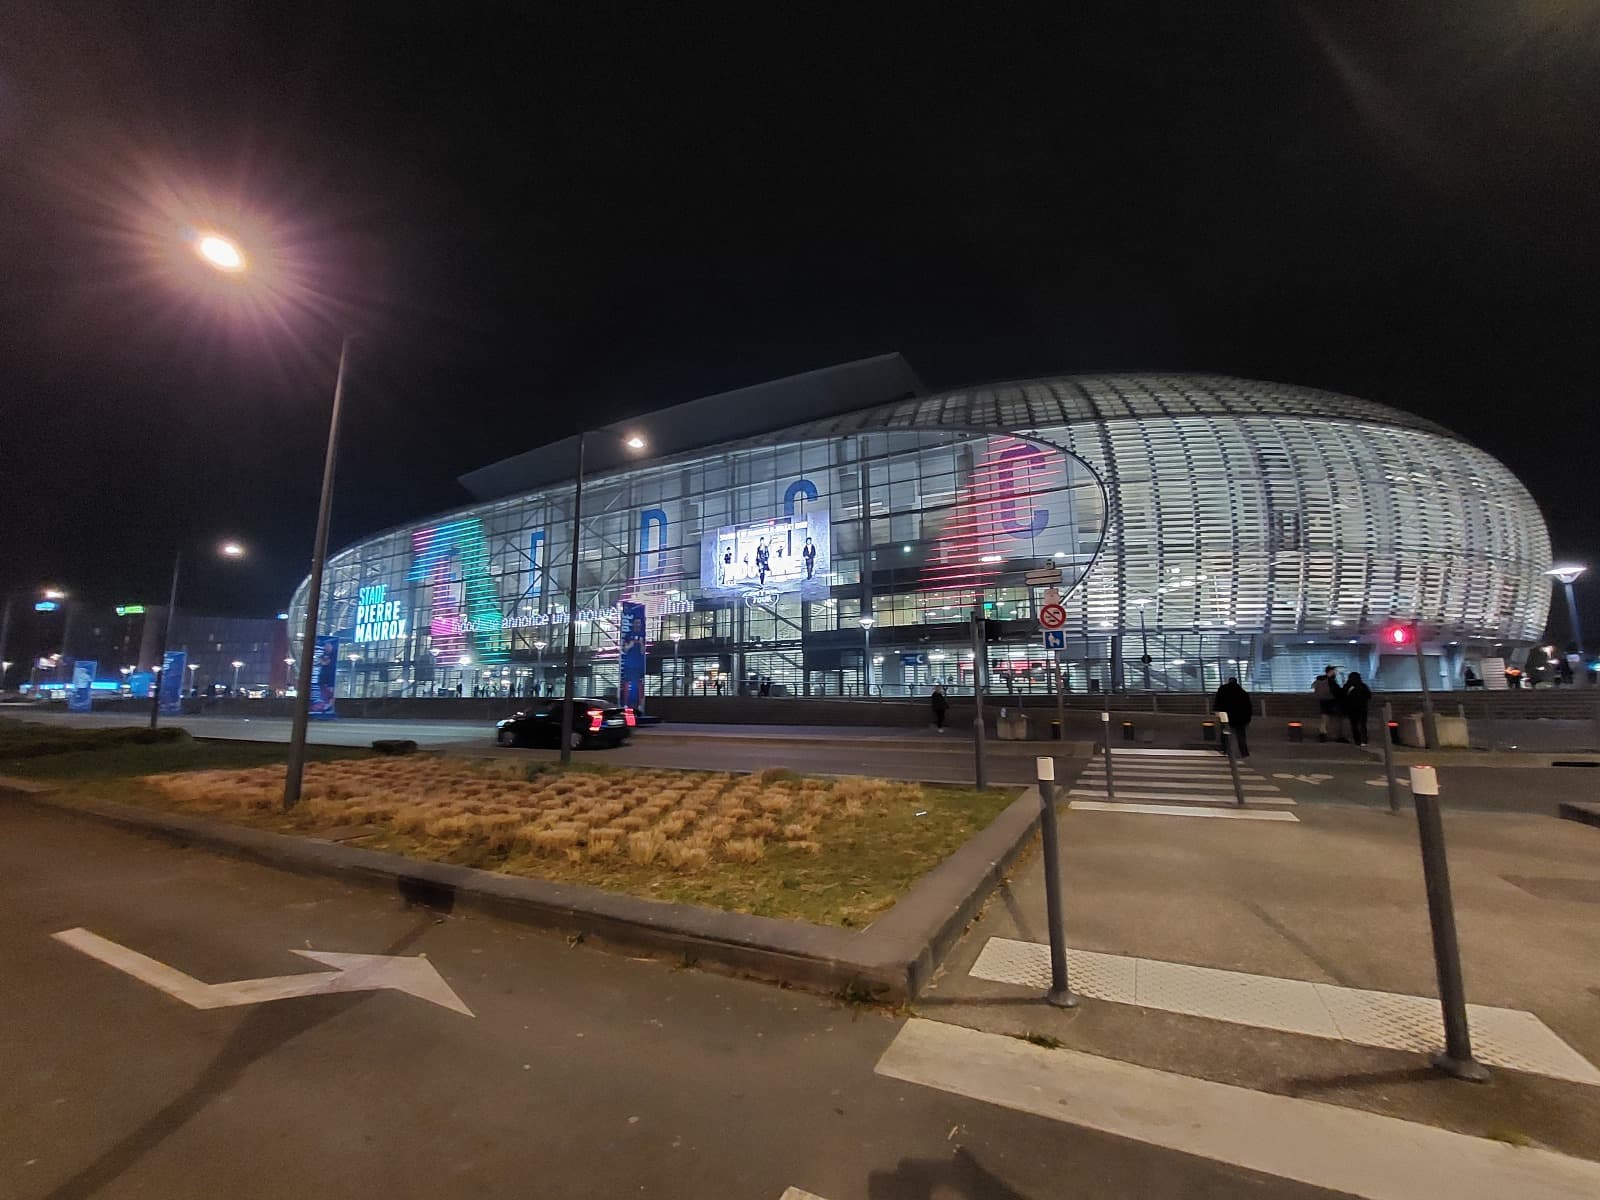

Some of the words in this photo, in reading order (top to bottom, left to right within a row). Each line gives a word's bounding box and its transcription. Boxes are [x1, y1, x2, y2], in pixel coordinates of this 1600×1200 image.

[359, 585, 387, 604] STADE
[356, 601, 401, 623] PIERRE
[355, 619, 406, 643] MAUROY
